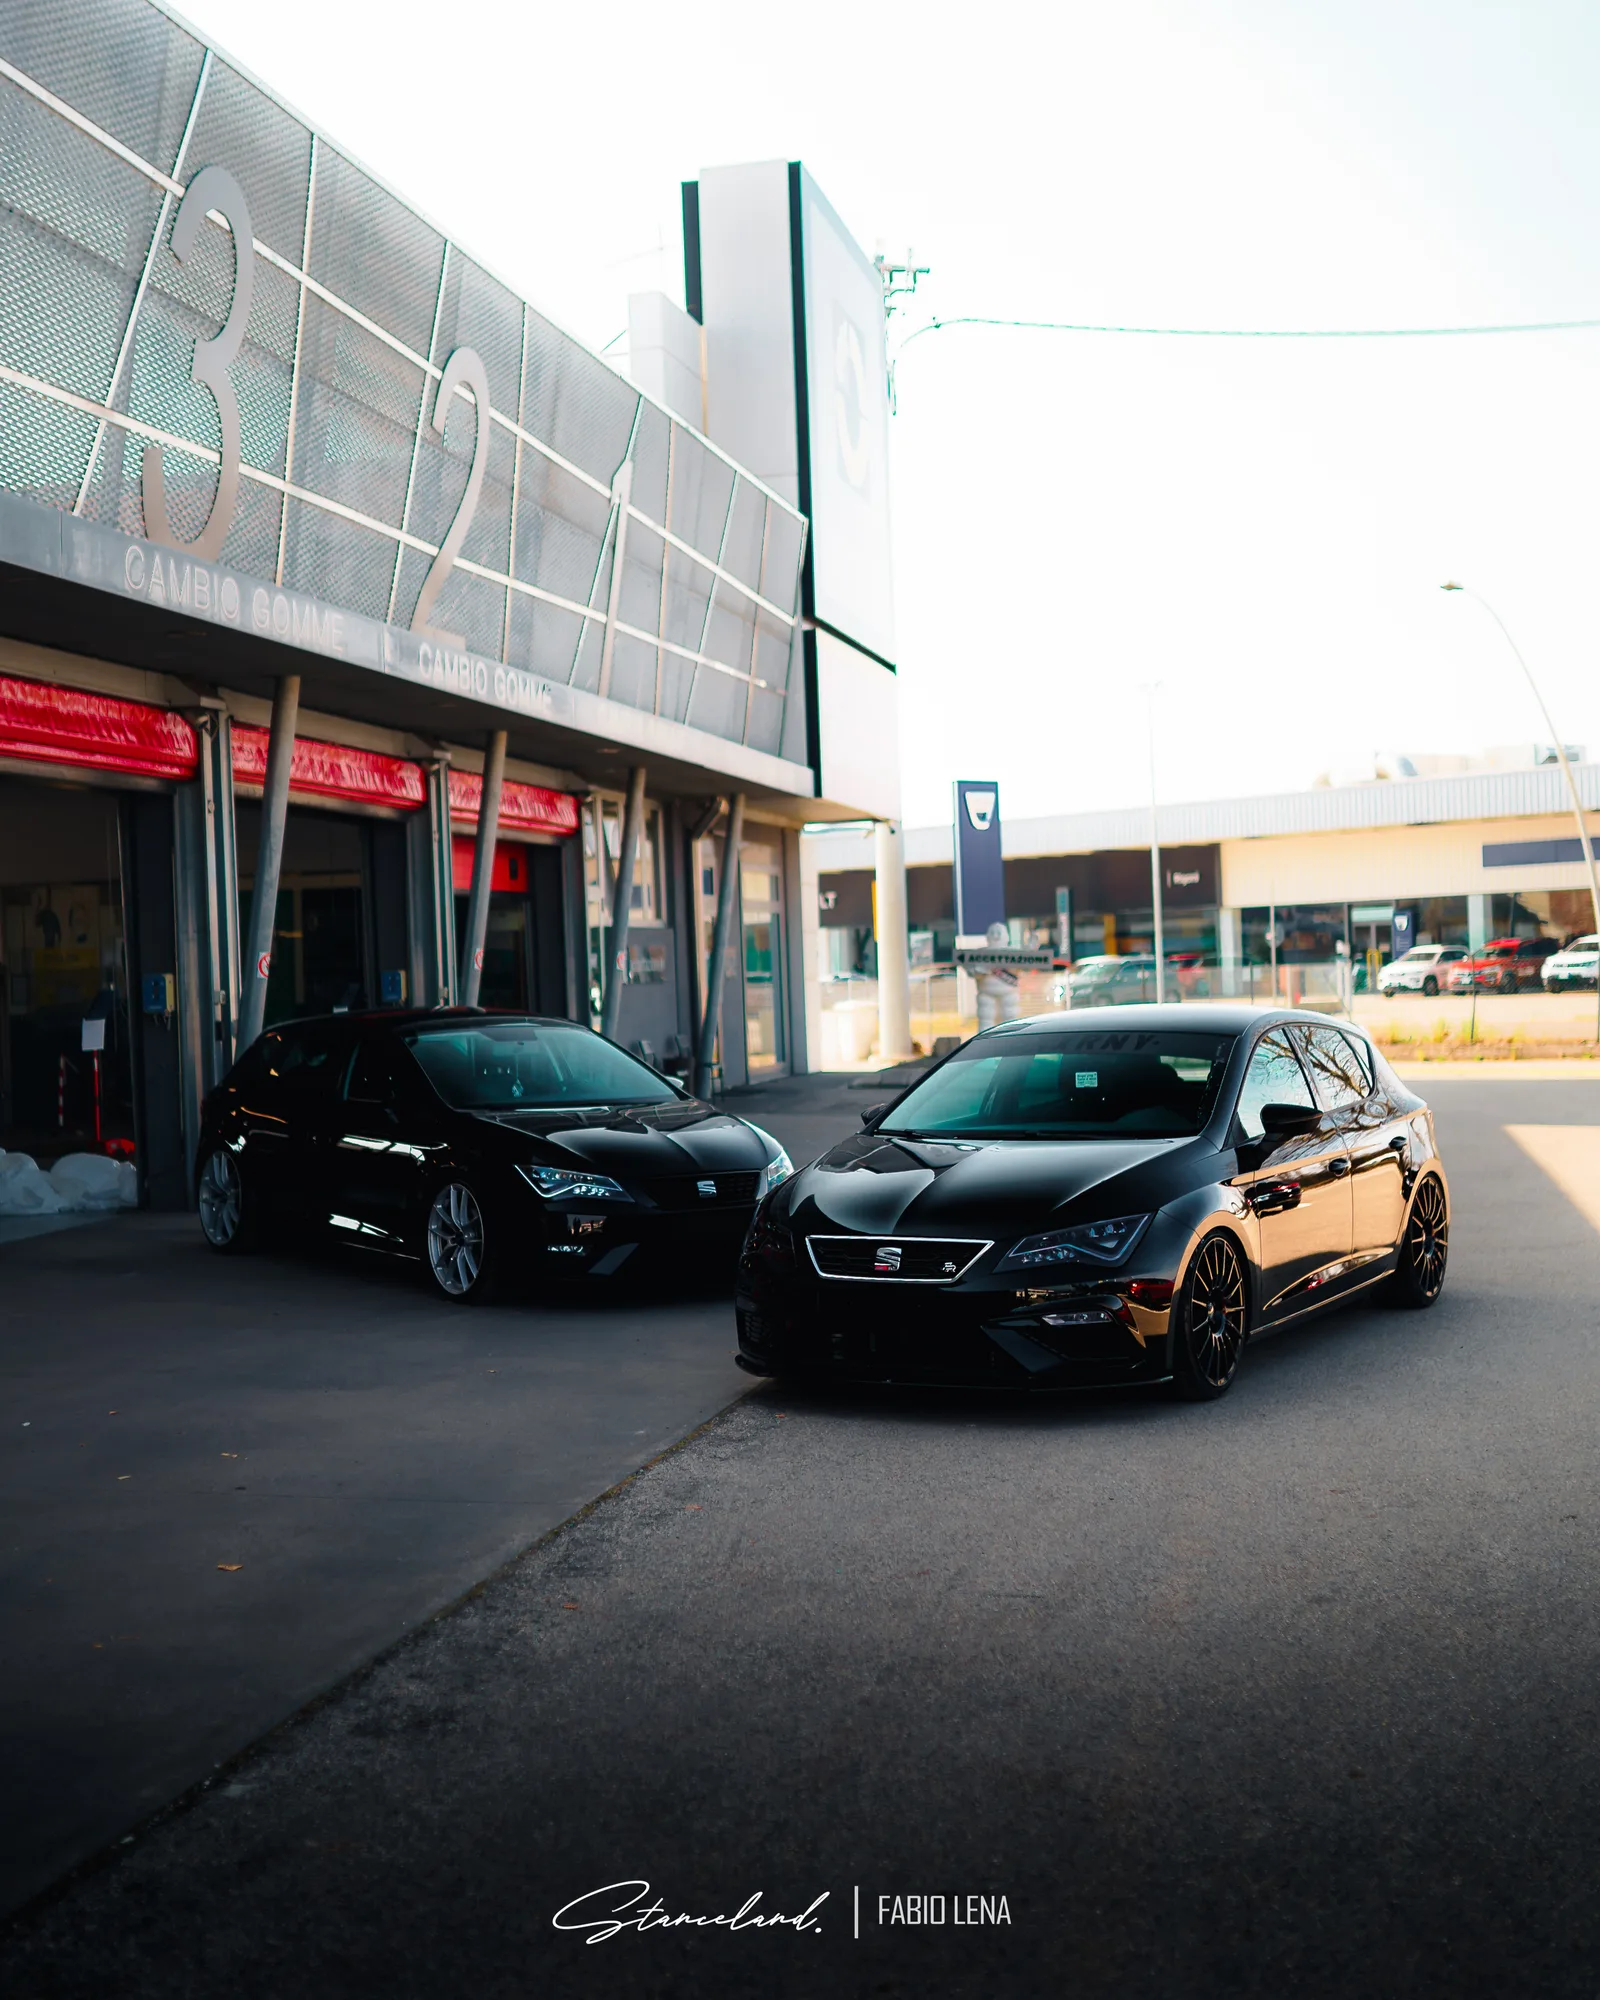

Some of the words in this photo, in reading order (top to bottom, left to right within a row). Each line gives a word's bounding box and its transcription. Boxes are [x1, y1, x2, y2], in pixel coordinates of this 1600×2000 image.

[142, 165, 254, 562] 3
[410, 346, 491, 650] 2
[124, 544, 241, 621] CAMBIO
[252, 587, 344, 651] GOMME
[419, 642, 487, 696] CAMBIO
[967, 953, 1050, 965] ACCETTAZIONE
